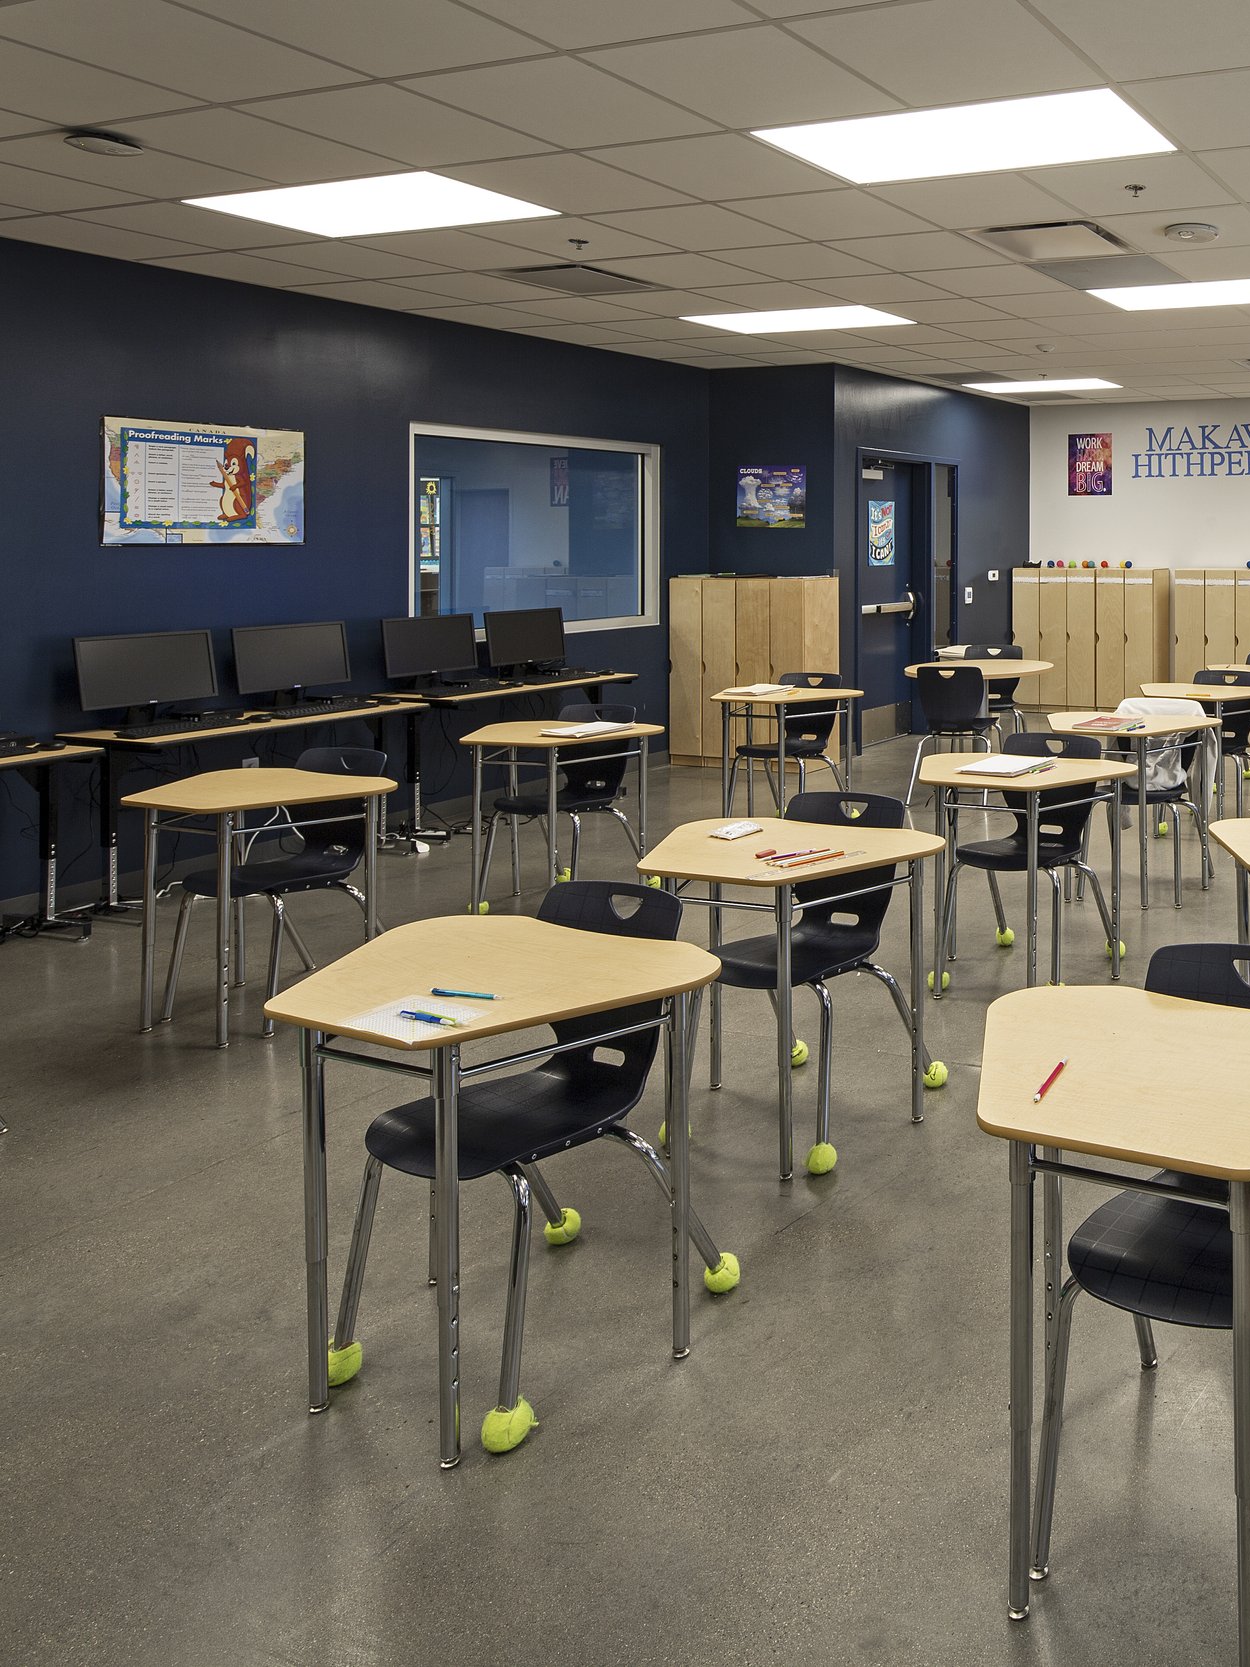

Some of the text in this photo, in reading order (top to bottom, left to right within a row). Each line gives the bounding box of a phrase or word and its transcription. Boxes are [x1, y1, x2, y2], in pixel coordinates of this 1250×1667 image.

[128, 430, 223, 444] Proofreading Marks
[1076, 437, 1103, 449] WORK
[1076, 461, 1104, 472] DREAM
[1076, 472, 1107, 492] BIG.
